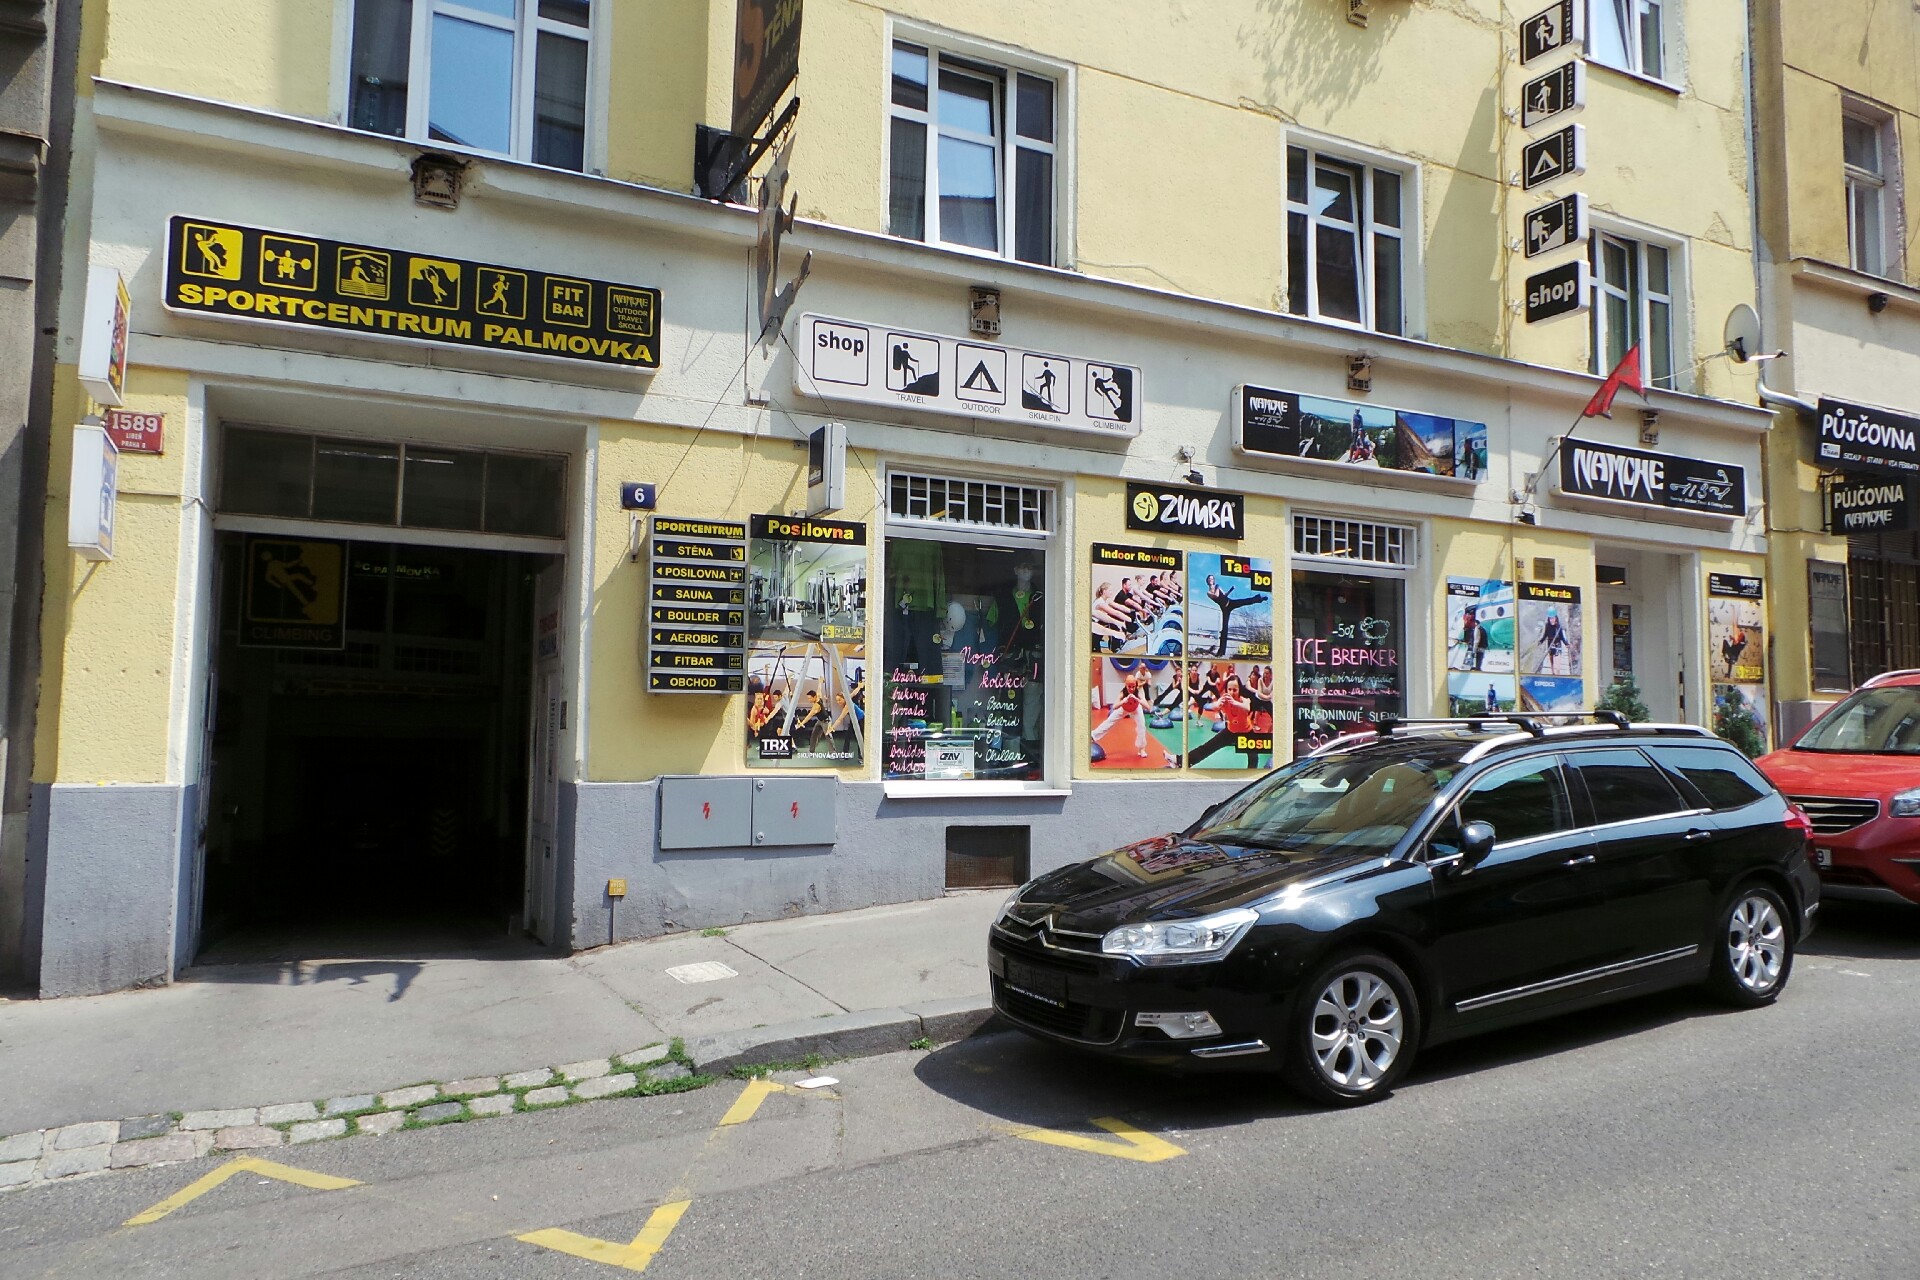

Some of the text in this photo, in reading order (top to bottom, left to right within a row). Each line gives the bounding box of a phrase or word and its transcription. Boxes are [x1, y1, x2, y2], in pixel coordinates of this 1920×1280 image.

[553, 285, 583, 302] FIT
[1529, 279, 1576, 309] shop
[552, 302, 584, 318] BAR
[613, 306, 648, 317] OUTDOOR
[178, 283, 654, 363] SPORTCENTRUM PALMOVKA
[618, 314, 644, 324] TRAVEL
[618, 321, 643, 331] ŠKOLA
[818, 331, 864, 357] shop
[896, 393, 926, 404] TRAVEL
[961, 402, 1001, 415] OUTDOOR
[112, 413, 158, 433] 1589
[1028, 411, 1061, 423] SKIALPIN
[1093, 420, 1127, 431] CLIMBING
[1822, 407, 1916, 453] PŮJČOVNA
[126, 432, 143, 440] LIBEŇ
[121, 440, 140, 449] PRAHA
[1573, 448, 1664, 501] NAMCHE
[634, 487, 645, 503] 6
[1834, 484, 1905, 509] PŮJČOVNA
[1159, 493, 1236, 530] ZUMBA
[655, 521, 744, 537] SPORTCENTRUM
[768, 519, 855, 540] Posilovna
[677, 544, 714, 557] STĚNA
[1101, 549, 1176, 567] Indoor Rowing
[665, 567, 726, 580] POSILOVNA
[1224, 559, 1251, 574] Tae
[1254, 572, 1271, 587] bo
[676, 589, 713, 601] SAUNA
[1529, 587, 1572, 599] Via Ferata
[667, 611, 720, 622] BOULDER
[251, 626, 333, 642] CLIMBING
[1332, 623, 1355, 639] -50%
[670, 632, 719, 645] AEROBIC
[960, 646, 1000, 664] Nová
[1295, 638, 1328, 666] ICE
[1331, 648, 1398, 667] BREAKER
[674, 656, 714, 667] FITBAR
[669, 678, 717, 689] OBCHOD
[978, 670, 1028, 689] kolekce
[1301, 687, 1319, 695] HOT
[761, 738, 789, 751] TRX
[1237, 736, 1272, 750] Bosu
[890, 760, 926, 773] outdoo
